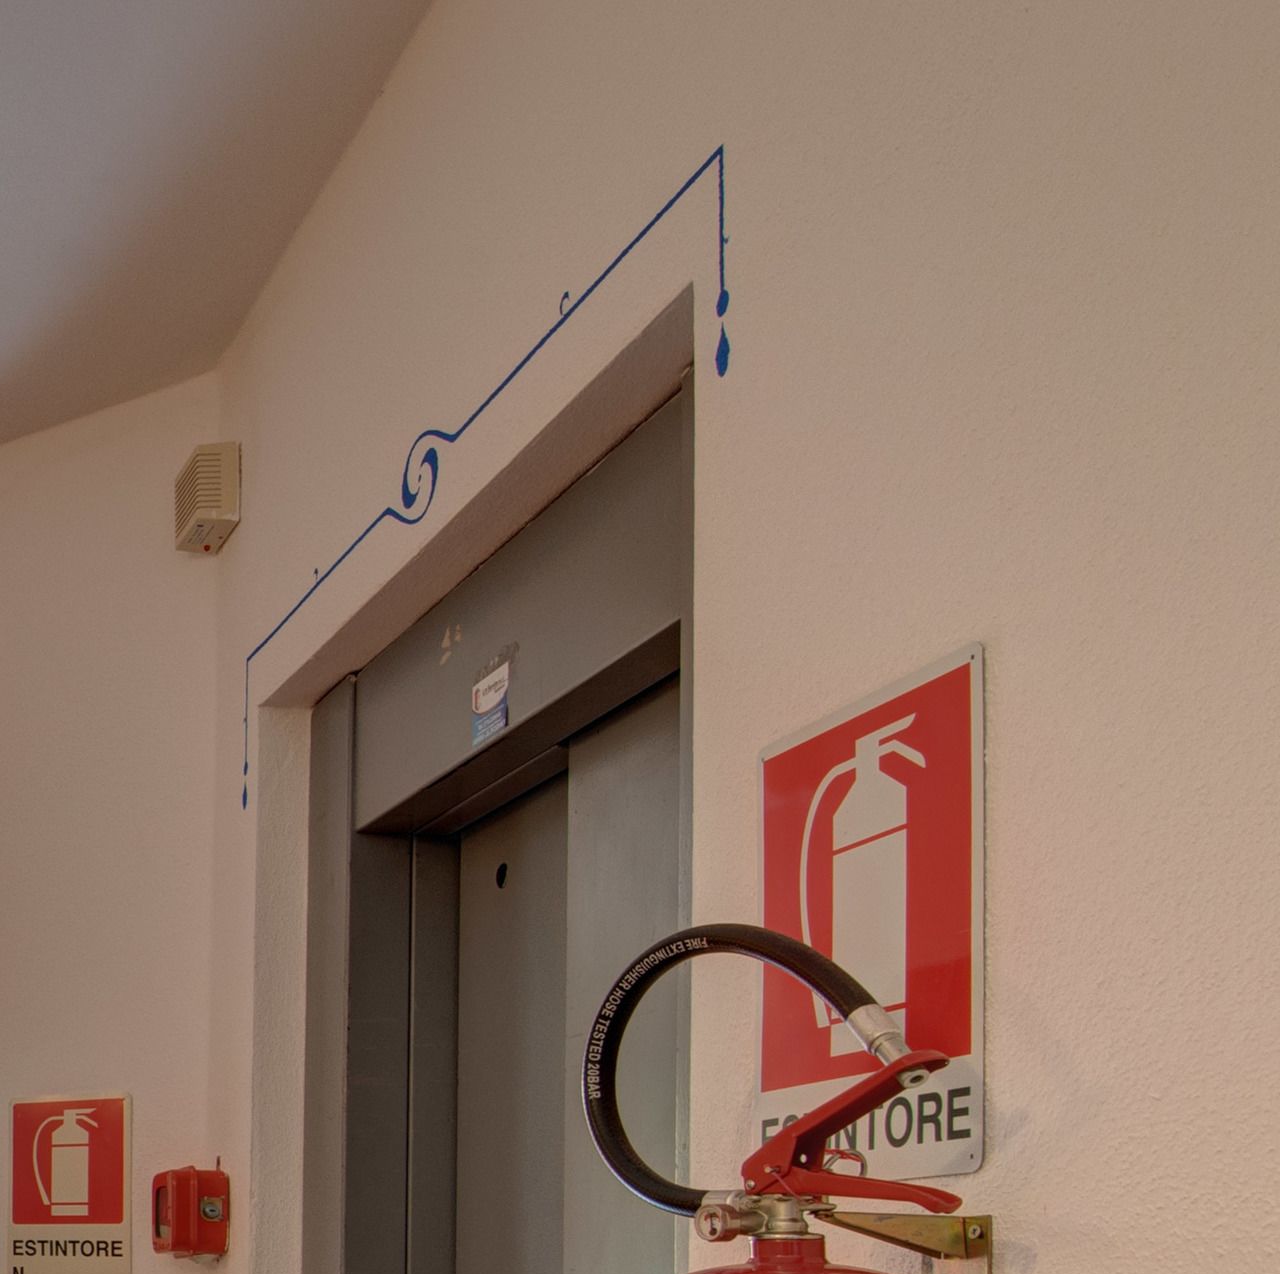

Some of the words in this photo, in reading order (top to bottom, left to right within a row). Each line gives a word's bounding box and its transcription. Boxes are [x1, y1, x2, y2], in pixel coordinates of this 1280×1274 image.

[684, 937, 709, 951] FIRE
[621, 941, 686, 991] EXTINGUISHER
[601, 990, 627, 1020] HOSE
[588, 1015, 611, 1062] TESTED
[586, 1062, 602, 1100] 20BAR
[12, 1239, 123, 1257] ESTINTORE
